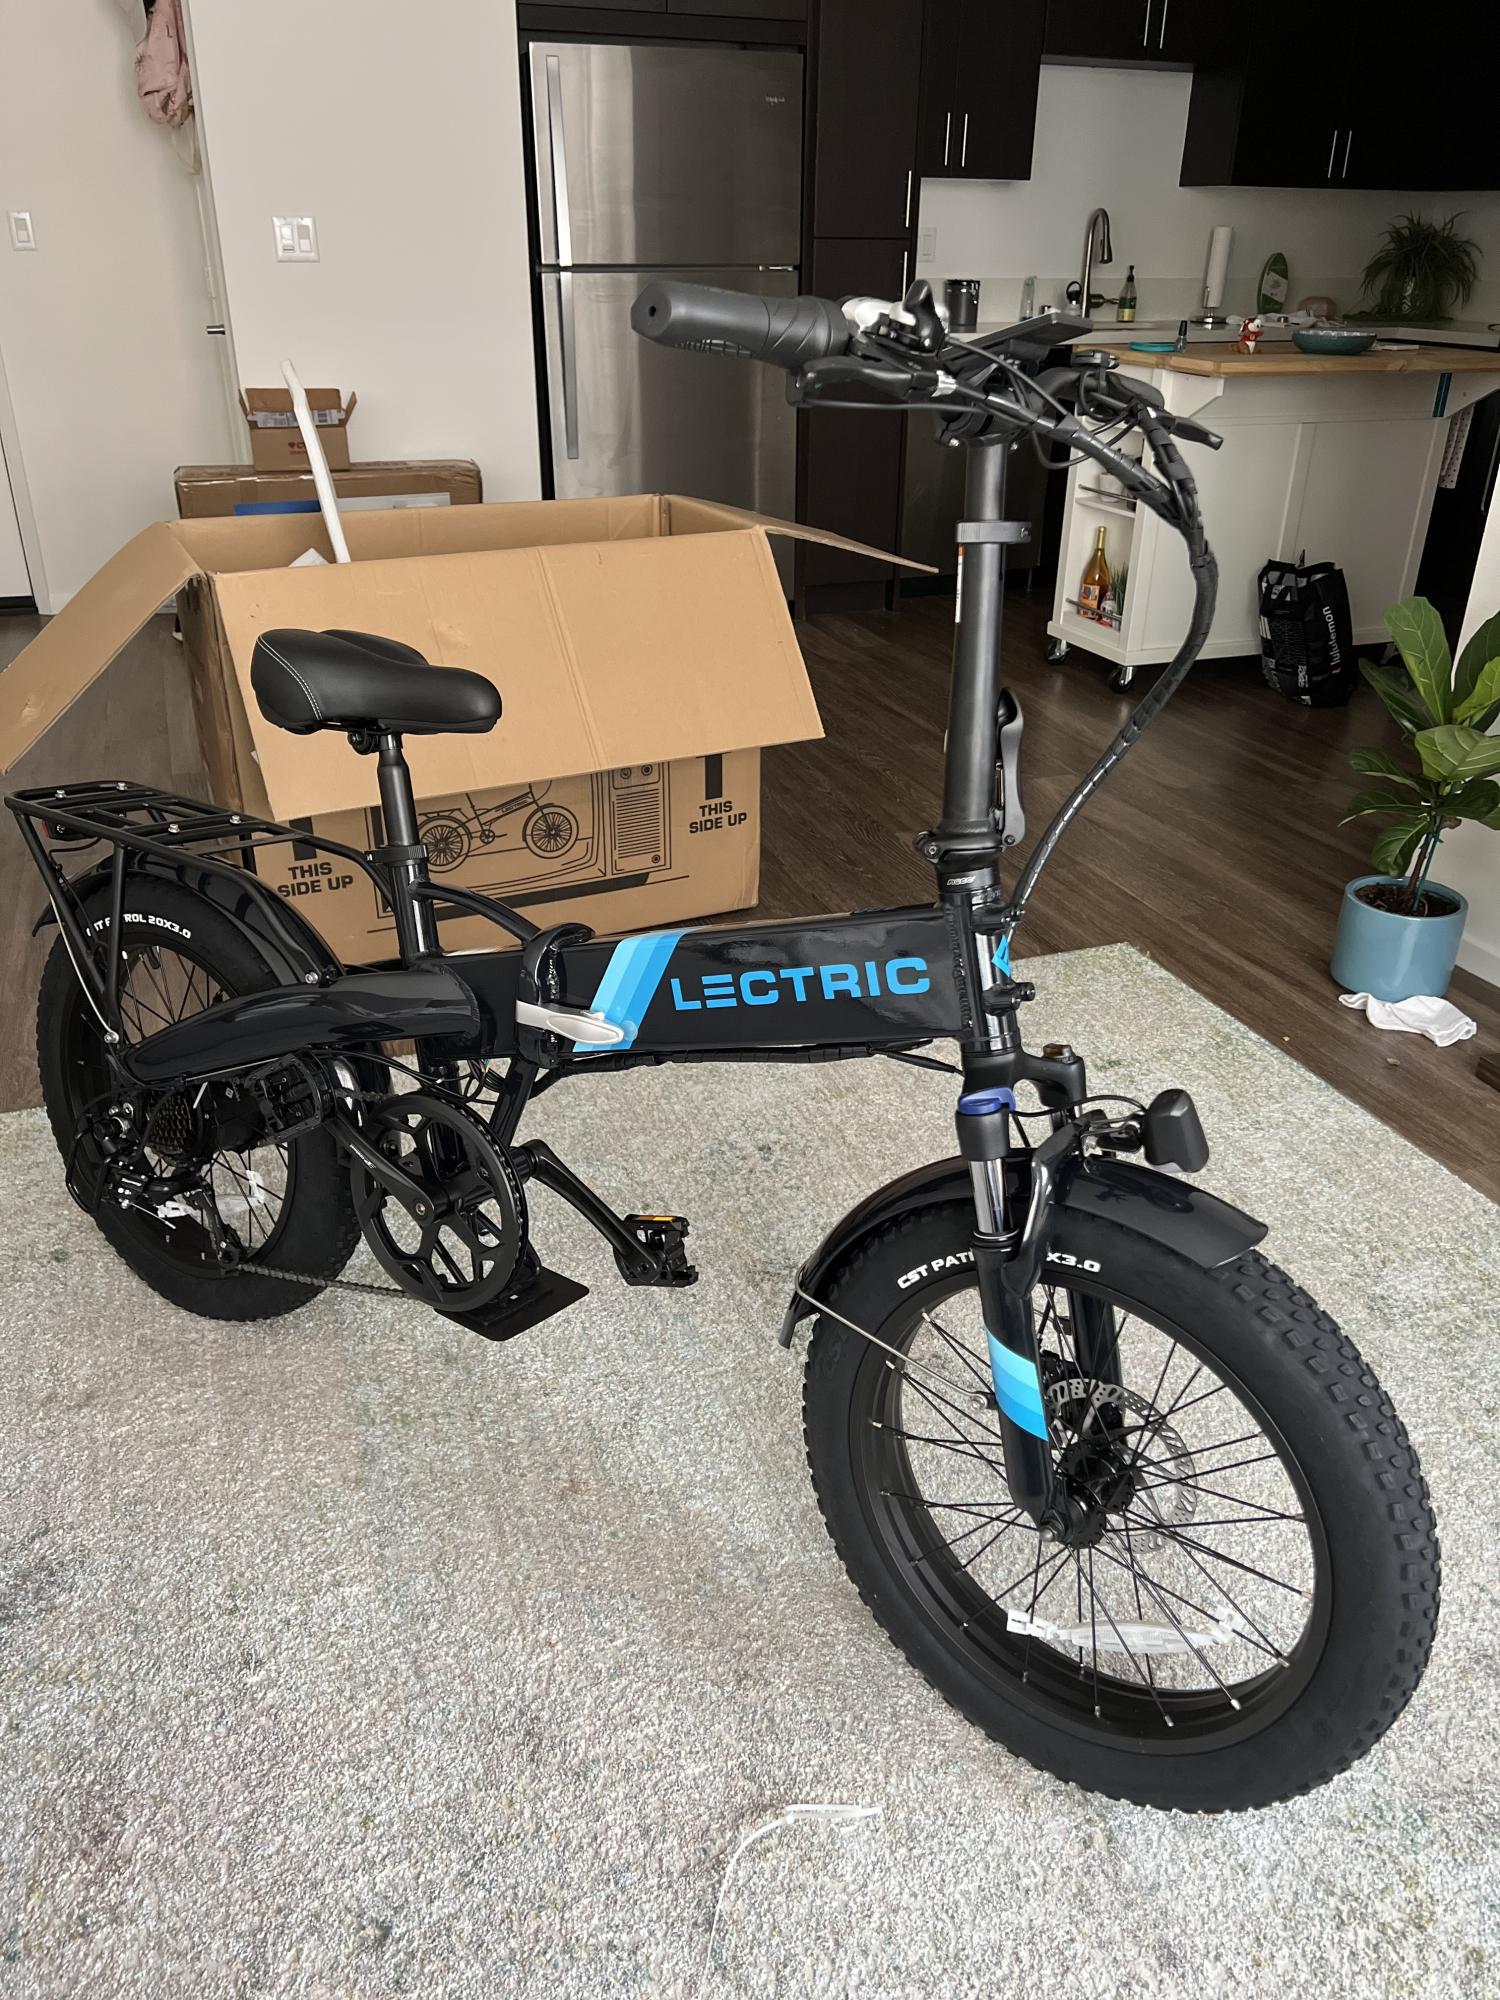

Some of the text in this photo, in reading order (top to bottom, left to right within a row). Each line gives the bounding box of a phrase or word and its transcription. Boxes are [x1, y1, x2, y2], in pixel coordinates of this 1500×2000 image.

[1322, 605, 1341, 666] lululemon
[698, 800, 733, 817] THIS
[689, 812, 747, 834] SIDE UP
[288, 861, 332, 880] THIS
[277, 874, 354, 897] SIDE UP
[147, 914, 192, 939] 20X3.0
[670, 956, 931, 1011] LECTRIC
[897, 1264, 928, 1289] CST
